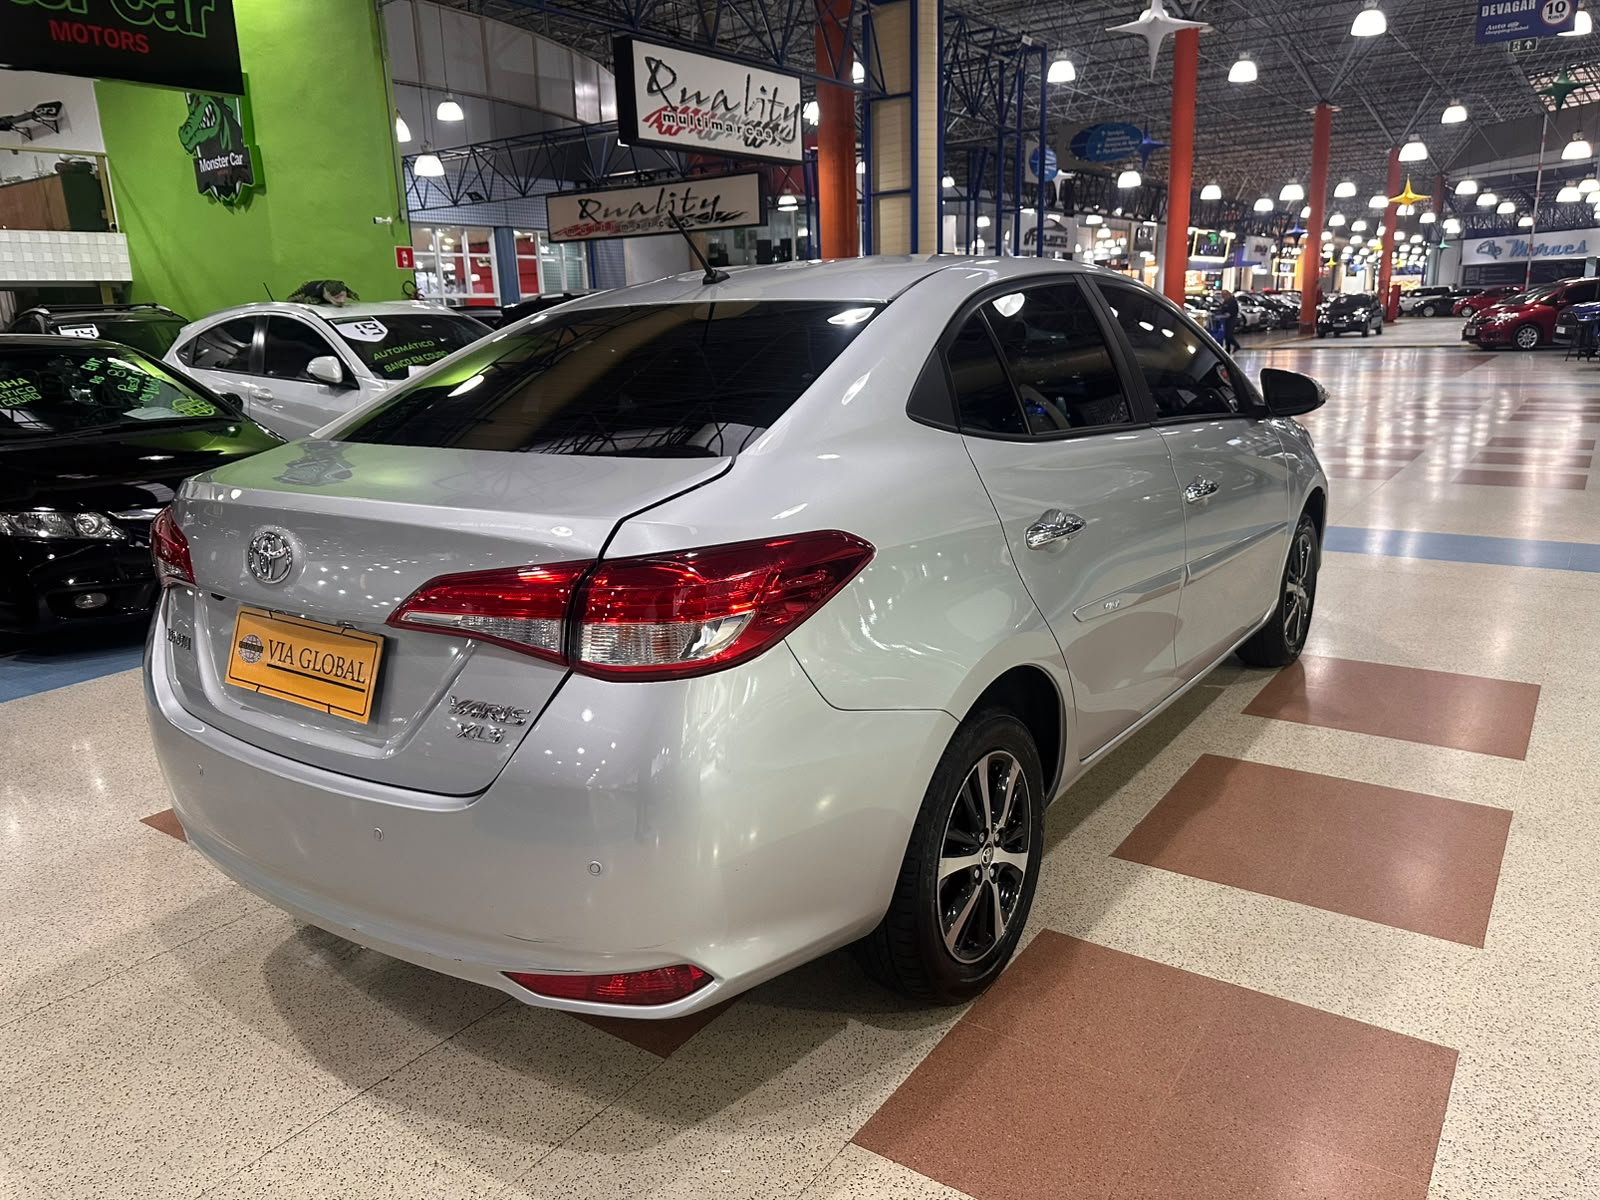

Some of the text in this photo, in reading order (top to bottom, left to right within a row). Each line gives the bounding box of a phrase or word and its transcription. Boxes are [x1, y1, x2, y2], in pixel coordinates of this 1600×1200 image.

[1481, 0, 1536, 17] DEVAGAR
[1546, 1, 1566, 14] 10
[49, 20, 150, 53] MOTORS
[645, 56, 800, 142] Quality
[662, 112, 772, 139] multimarcas
[199, 155, 228, 173] Monster
[230, 152, 243, 166] Car
[578, 187, 721, 222] Quality
[373, 340, 434, 360] AUTOMÁTICO
[384, 357, 412, 373] BANCO
[411, 354, 424, 364] EM
[2, 392, 42, 407] COURO
[268, 639, 295, 666] VIA
[299, 647, 366, 684] GLOBAL
